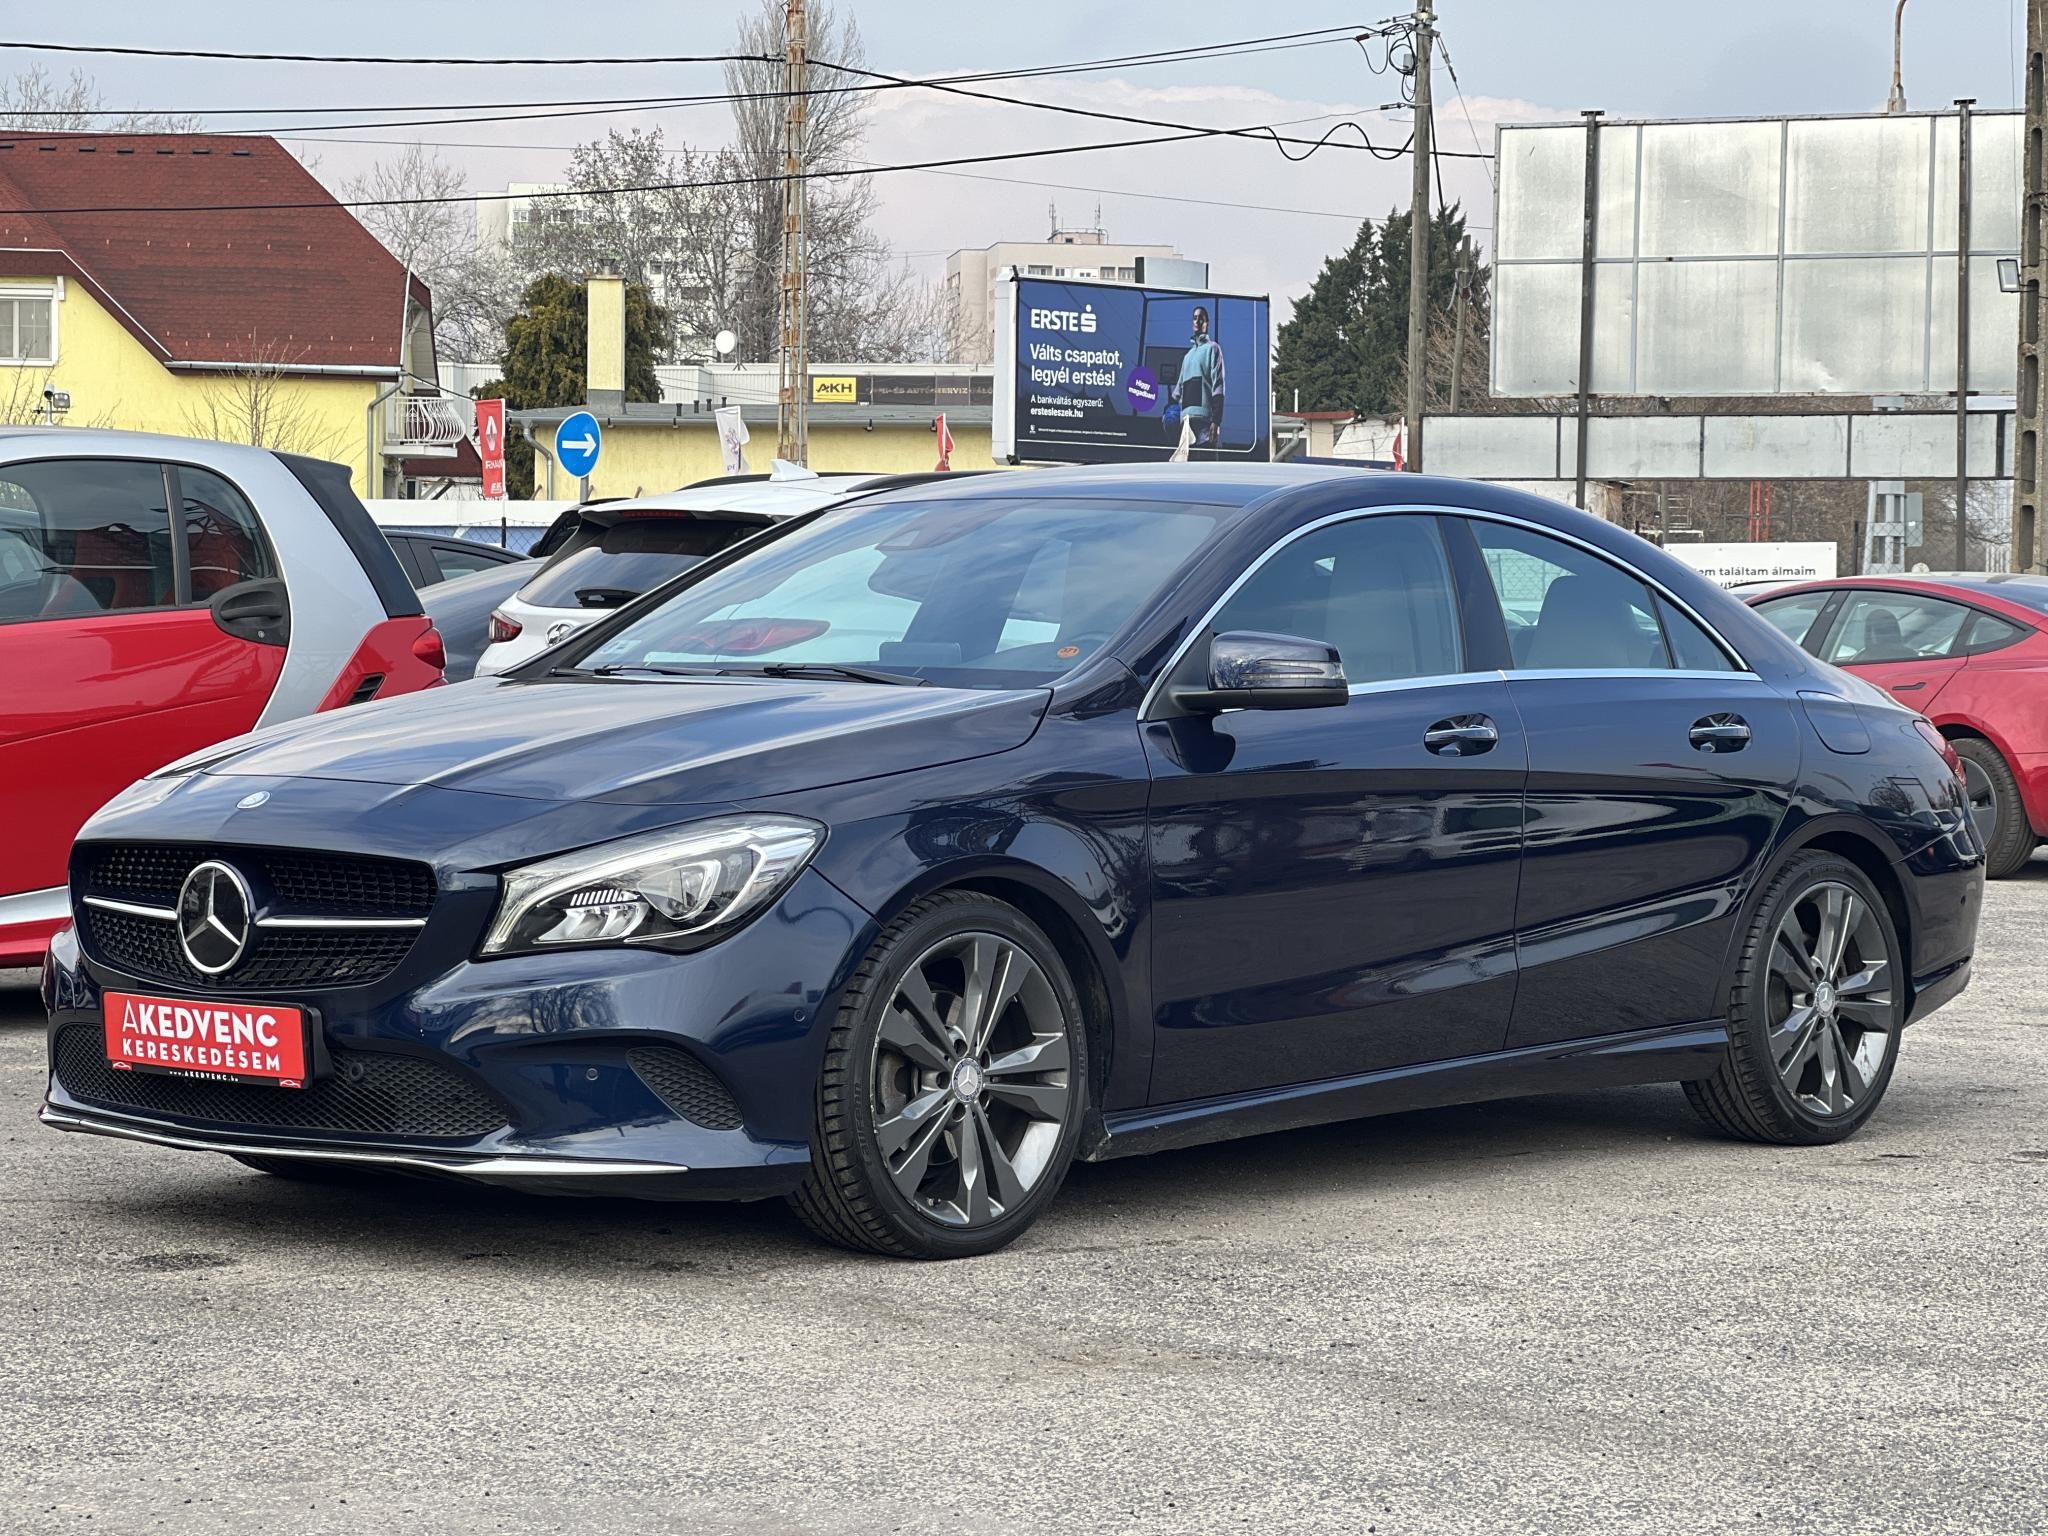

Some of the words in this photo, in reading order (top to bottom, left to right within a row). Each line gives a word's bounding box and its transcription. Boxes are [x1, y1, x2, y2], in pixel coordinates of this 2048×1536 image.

[1030, 308, 1079, 332] ERSTE
[1030, 343, 1062, 361] Válts
[1065, 348, 1123, 369] csapatot,
[1032, 365, 1069, 386] legyél
[1072, 370, 1115, 386] erstés!
[1031, 394, 1036, 404] A
[1037, 395, 1072, 406] bankváltás
[1072, 397, 1104, 408] egyszerű:
[1030, 407, 1084, 418] erstesleszek.hu
[1719, 567, 1768, 576] találtam
[1772, 566, 1816, 576] álmaim
[122, 999, 279, 1047] AKEDVENC
[123, 1038, 280, 1071] KERESKEDÉSEM
